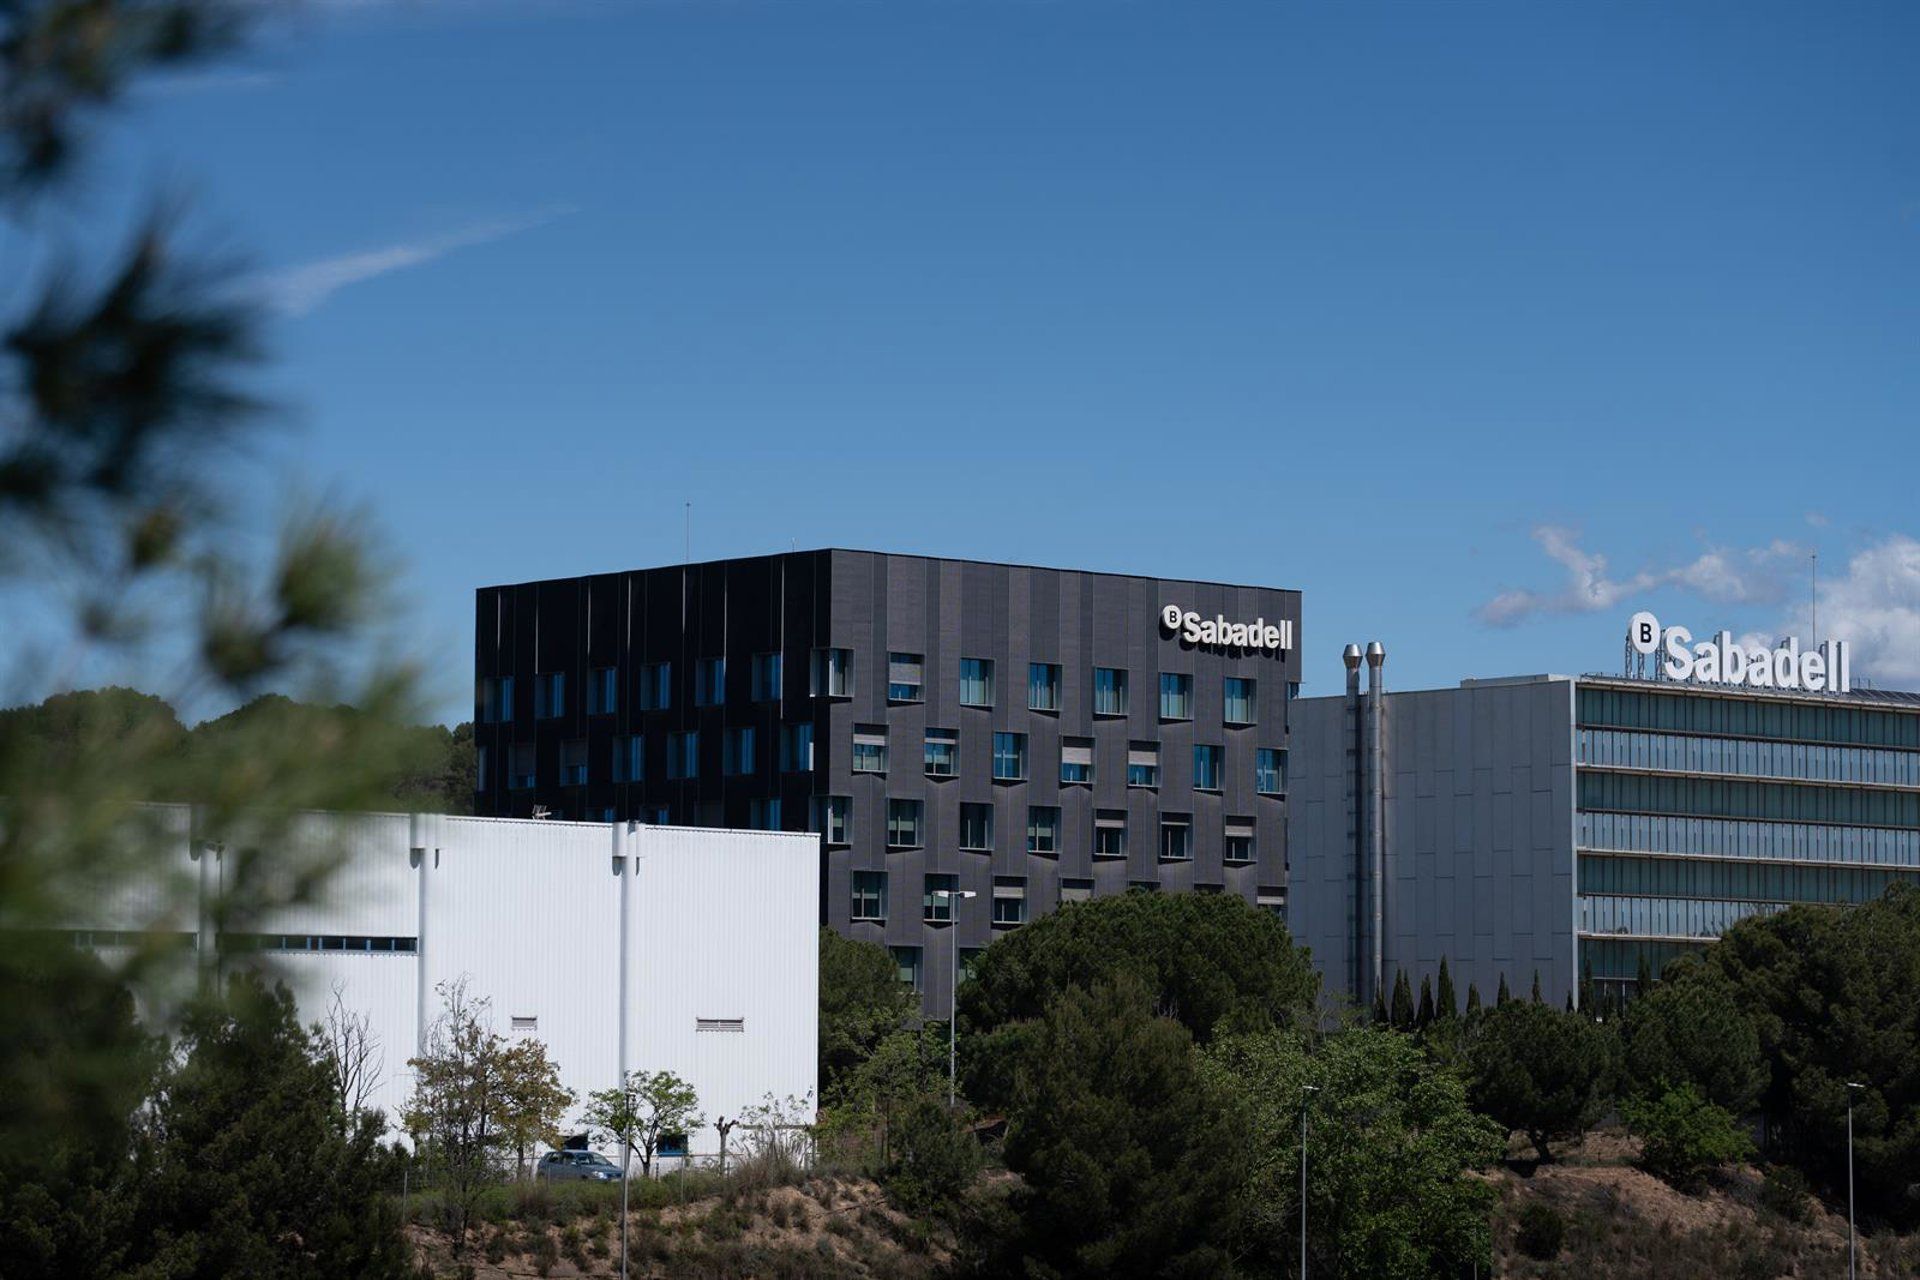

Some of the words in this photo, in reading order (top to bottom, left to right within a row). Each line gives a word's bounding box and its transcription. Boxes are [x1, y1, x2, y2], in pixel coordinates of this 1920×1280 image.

[1182, 611, 1293, 650] Sabadell
[1640, 623, 1651, 643] B
[1664, 625, 1850, 693] Sabadell
